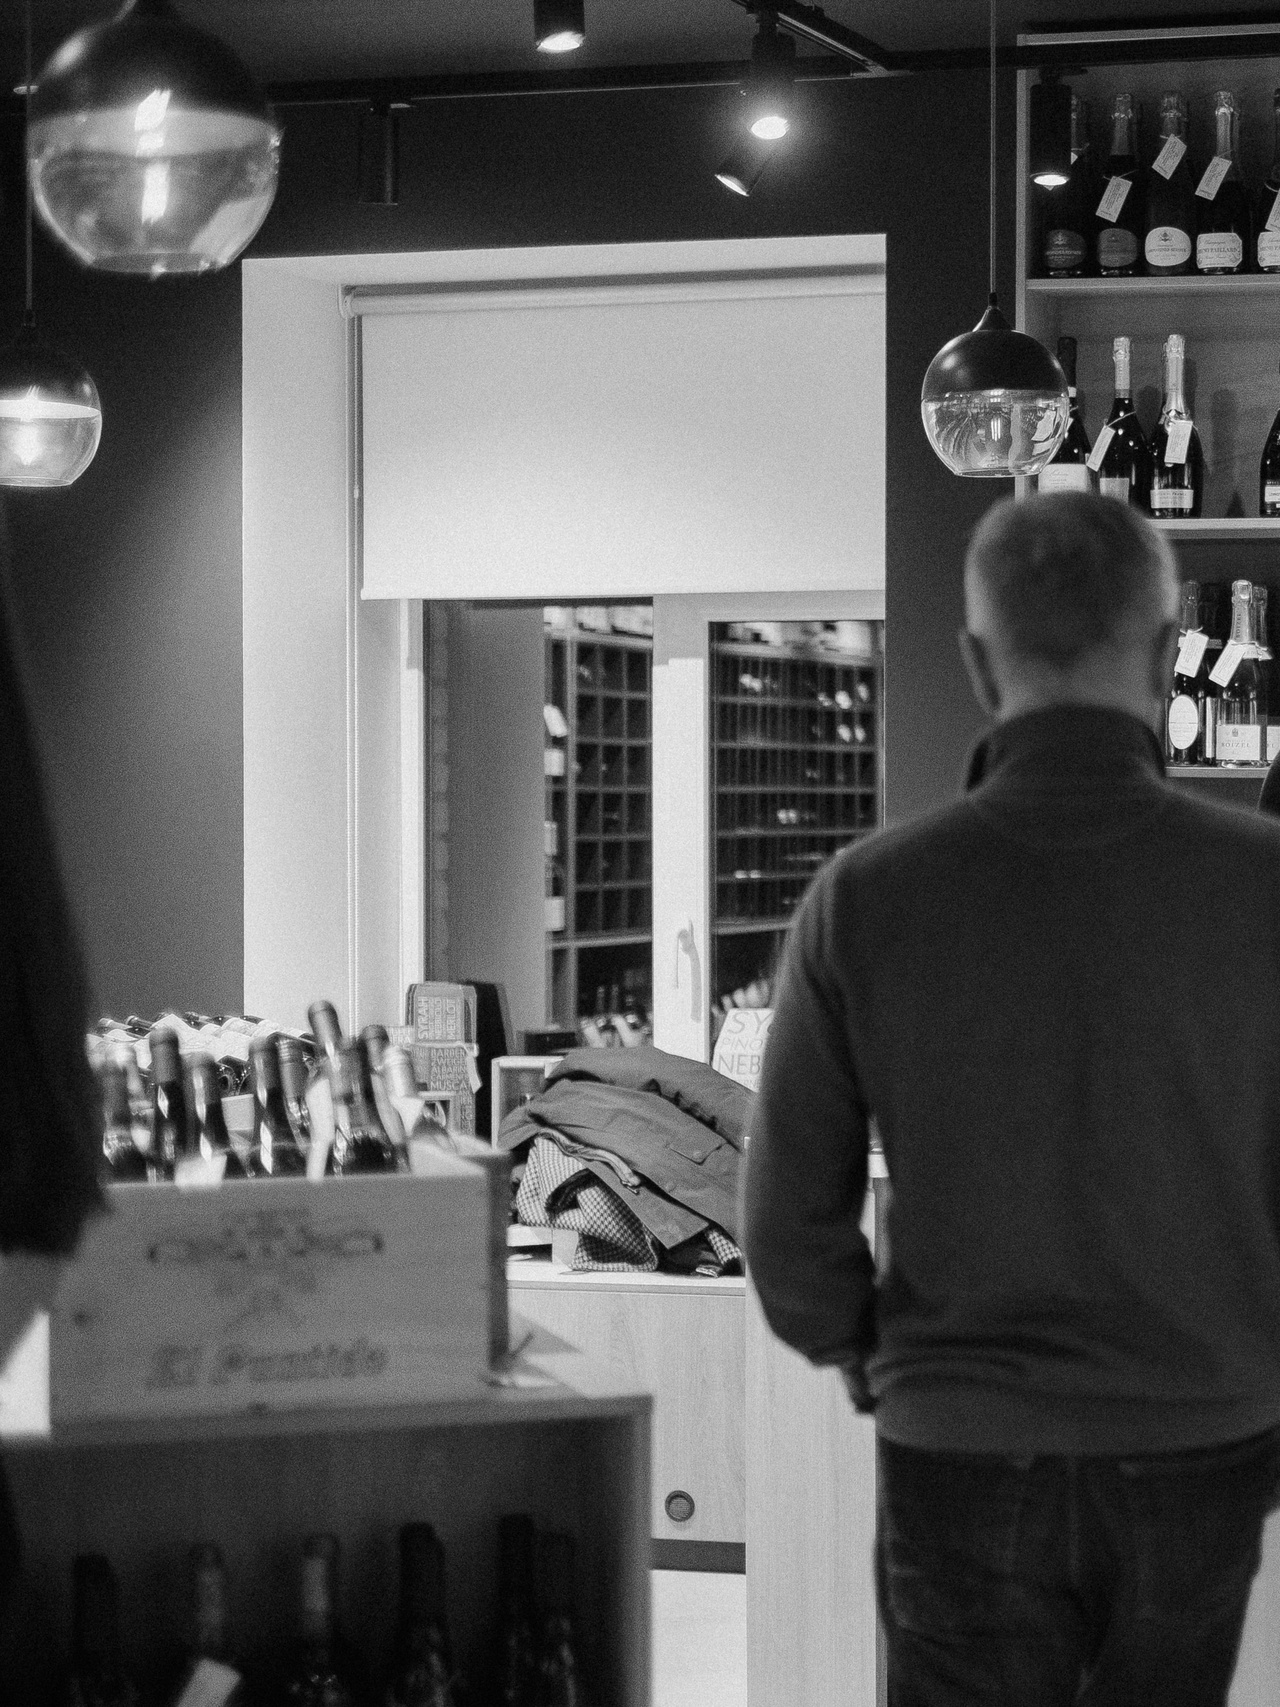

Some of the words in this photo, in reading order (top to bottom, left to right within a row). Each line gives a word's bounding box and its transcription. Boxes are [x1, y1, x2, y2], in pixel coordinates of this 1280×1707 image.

[417, 996, 429, 1039] SYRAH
[446, 998, 456, 1039] MERLOT
[718, 1054, 761, 1075] NEB
